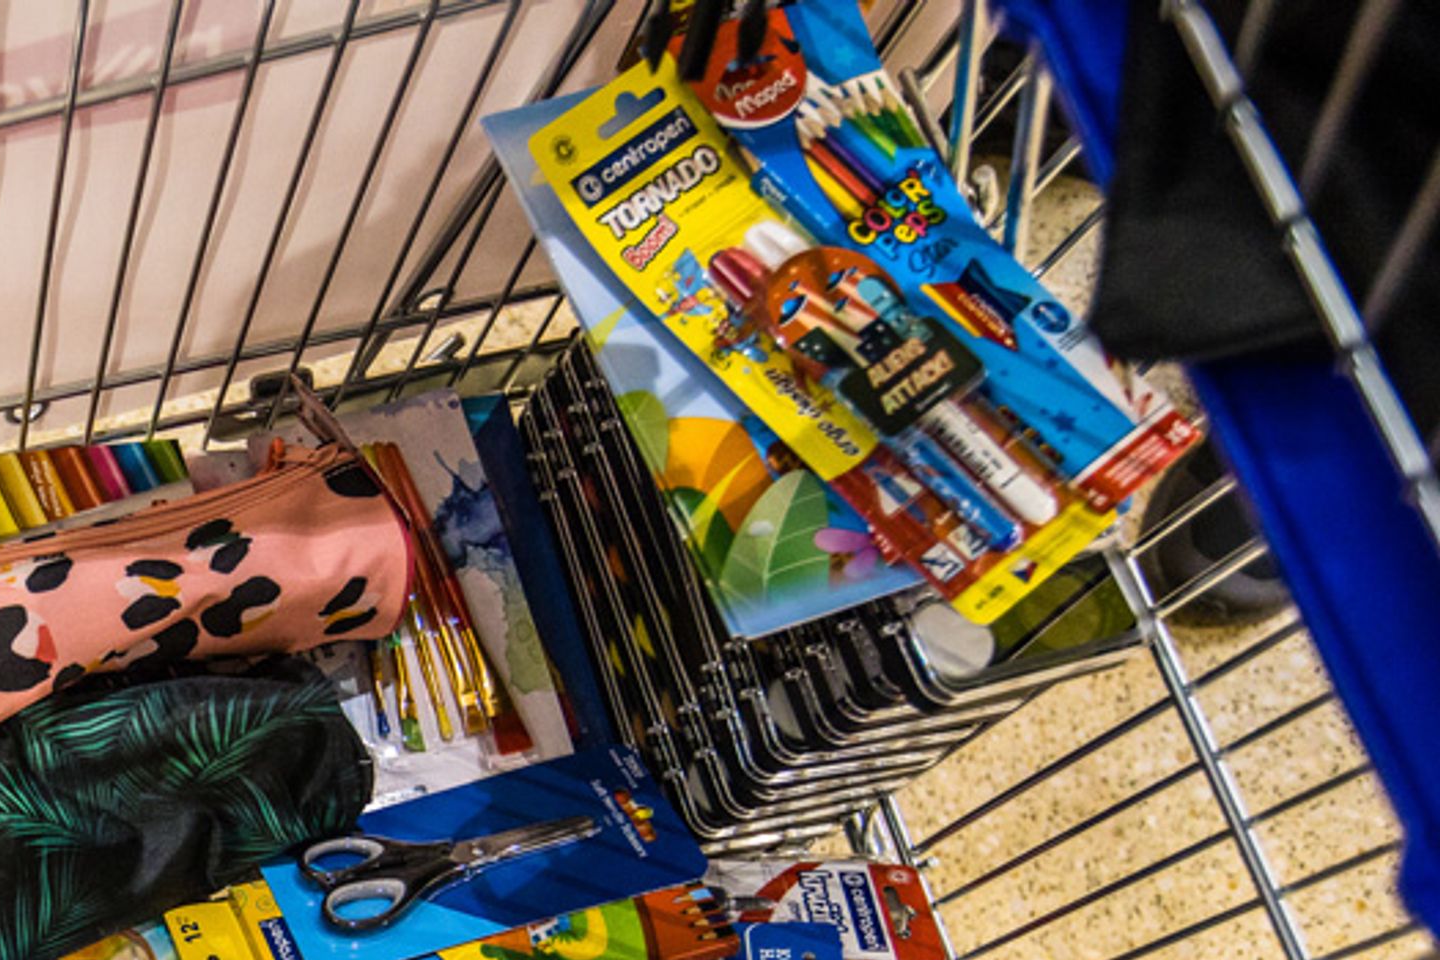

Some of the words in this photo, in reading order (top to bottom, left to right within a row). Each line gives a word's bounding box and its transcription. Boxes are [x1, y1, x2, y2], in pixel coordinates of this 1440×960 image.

[733, 70, 798, 121] Maped
[602, 113, 690, 184] centropen
[596, 147, 719, 240] TORNADO
[621, 215, 679, 274] Boom!
[849, 886, 880, 951] centropen
